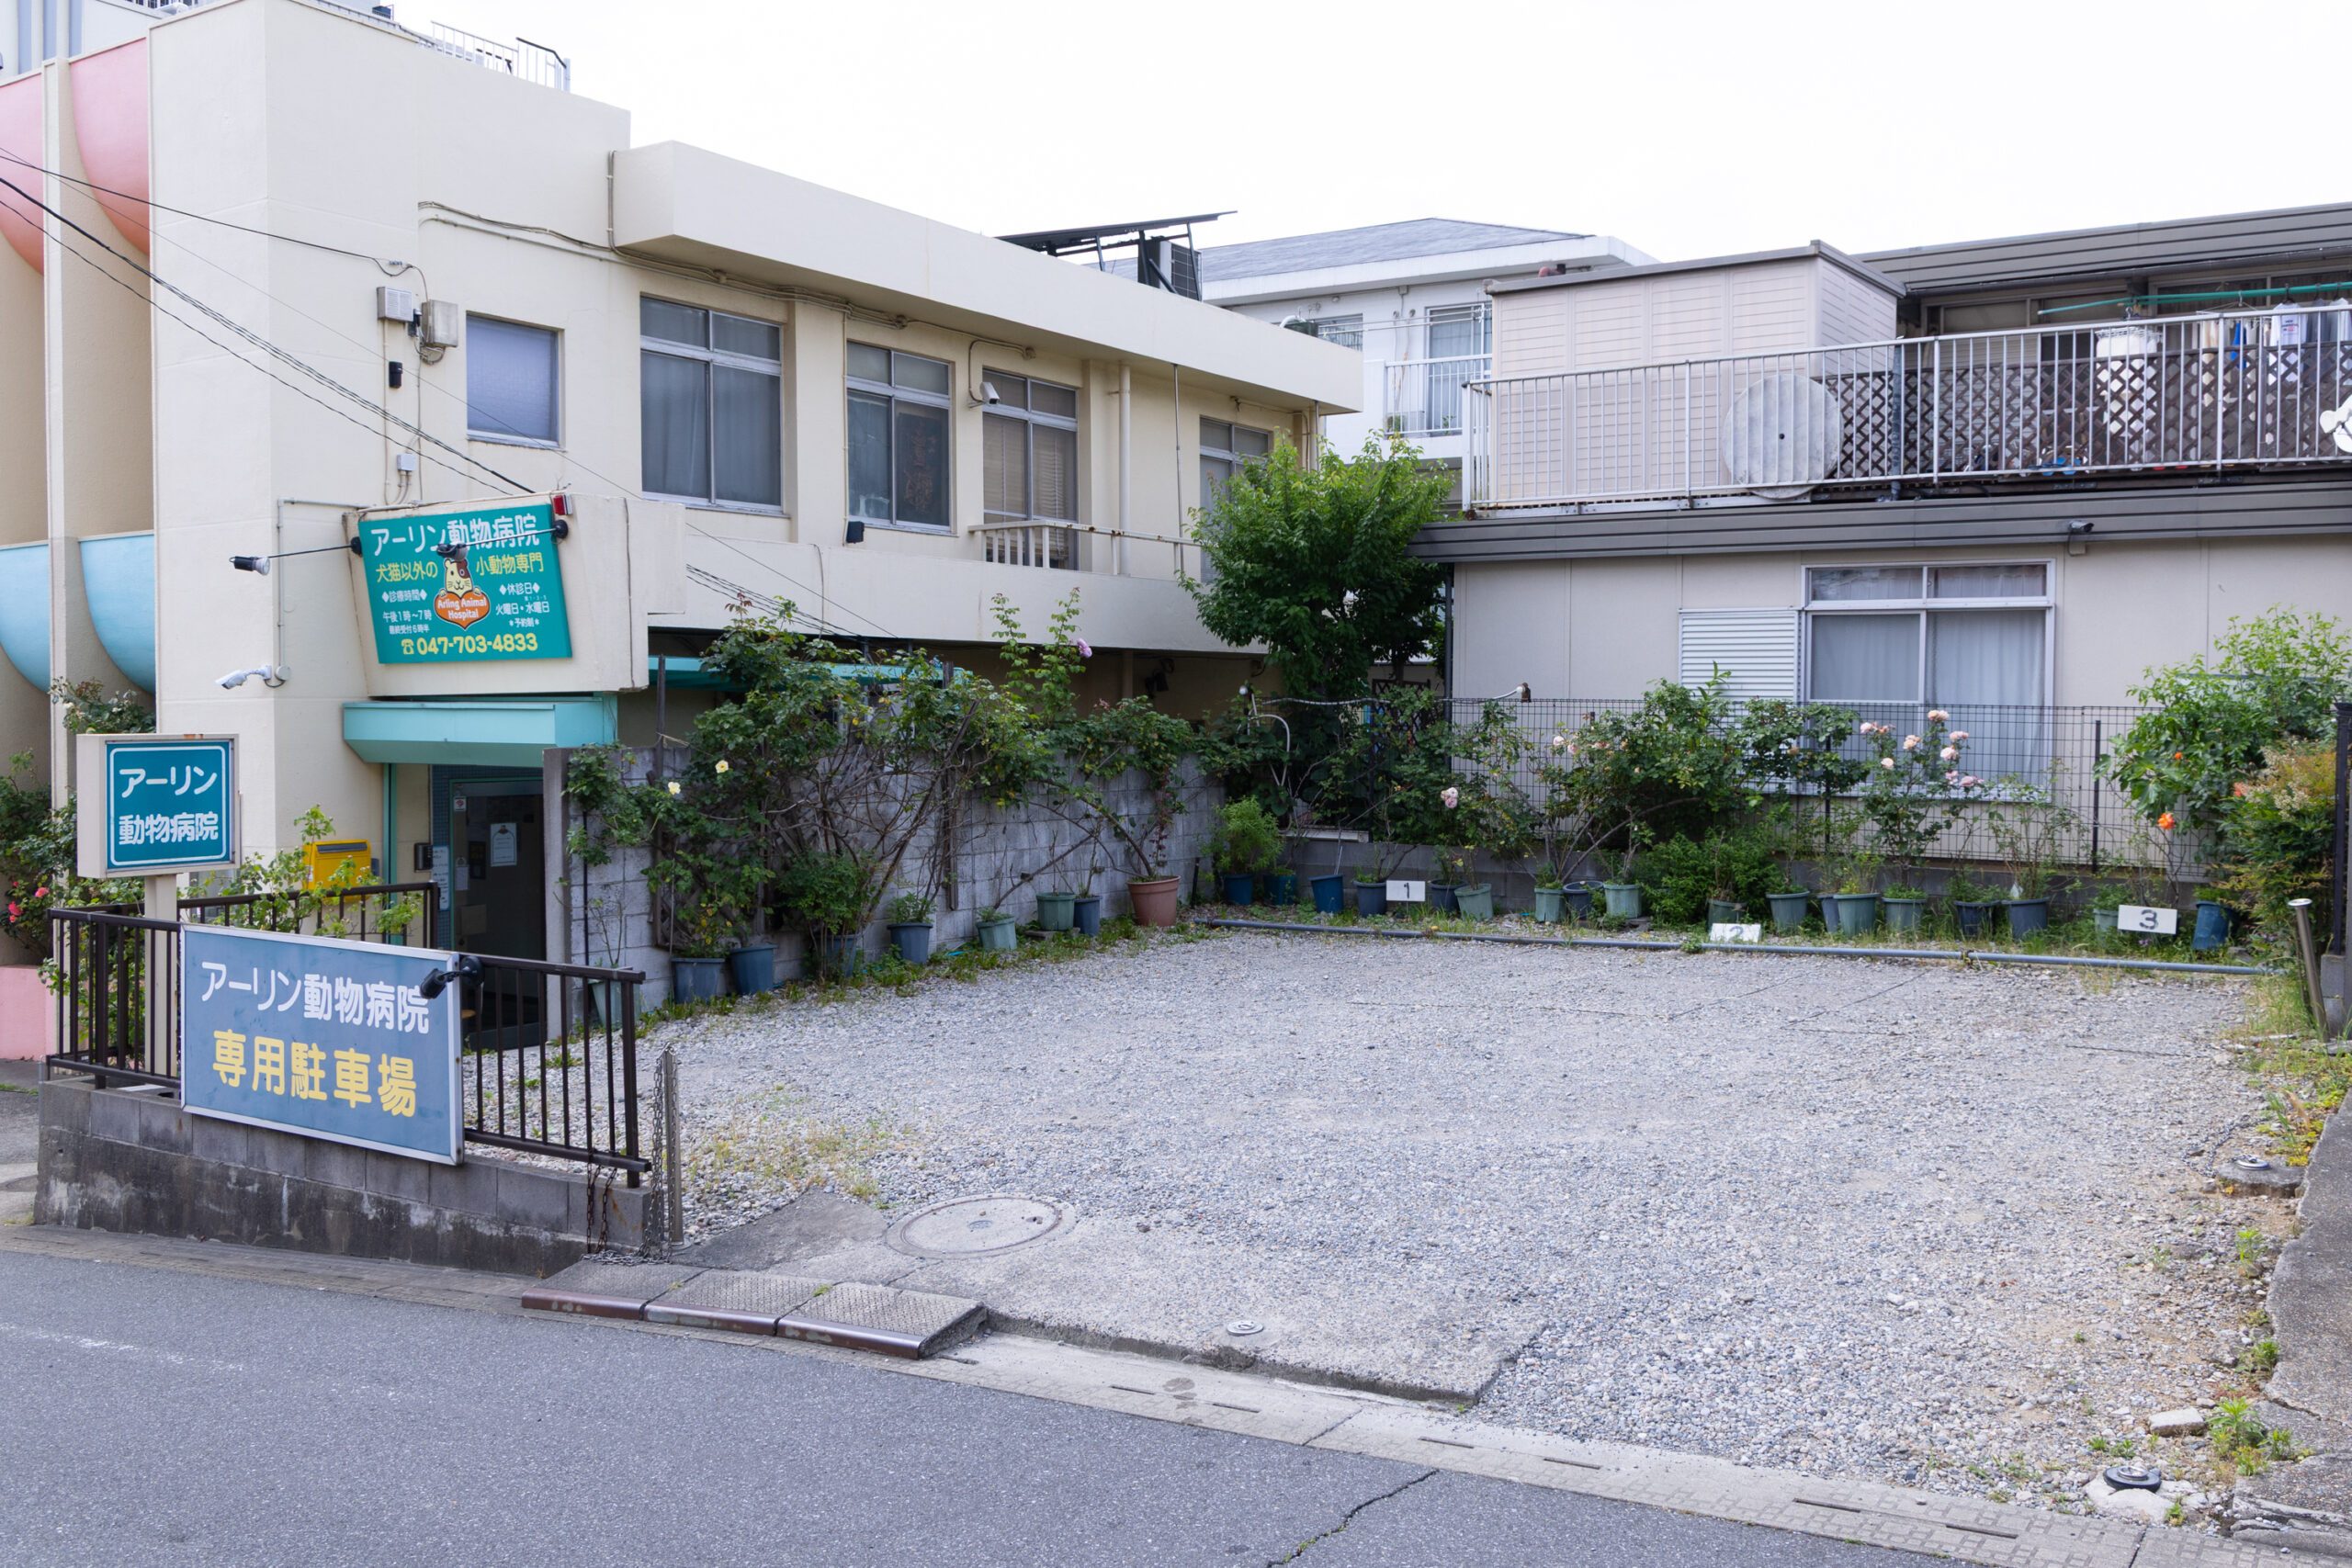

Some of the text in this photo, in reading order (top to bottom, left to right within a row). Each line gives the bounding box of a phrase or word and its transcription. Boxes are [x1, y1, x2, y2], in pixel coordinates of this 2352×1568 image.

[370, 513, 540, 557] アーリン動物病院
[376, 552, 544, 583] 犬猫以外の 小動物専門
[437, 597, 487, 610] Arling Animal
[447, 608, 479, 621] Hospital
[416, 633, 539, 656] 047-703-4833
[119, 765, 218, 798] アーリン
[119, 811, 219, 845] 動物病院
[1729, 925, 1745, 942] 2
[2139, 908, 2159, 930] 3
[201, 961, 430, 1034] アーリン動物病院
[212, 1028, 417, 1118] 専用駐車場
